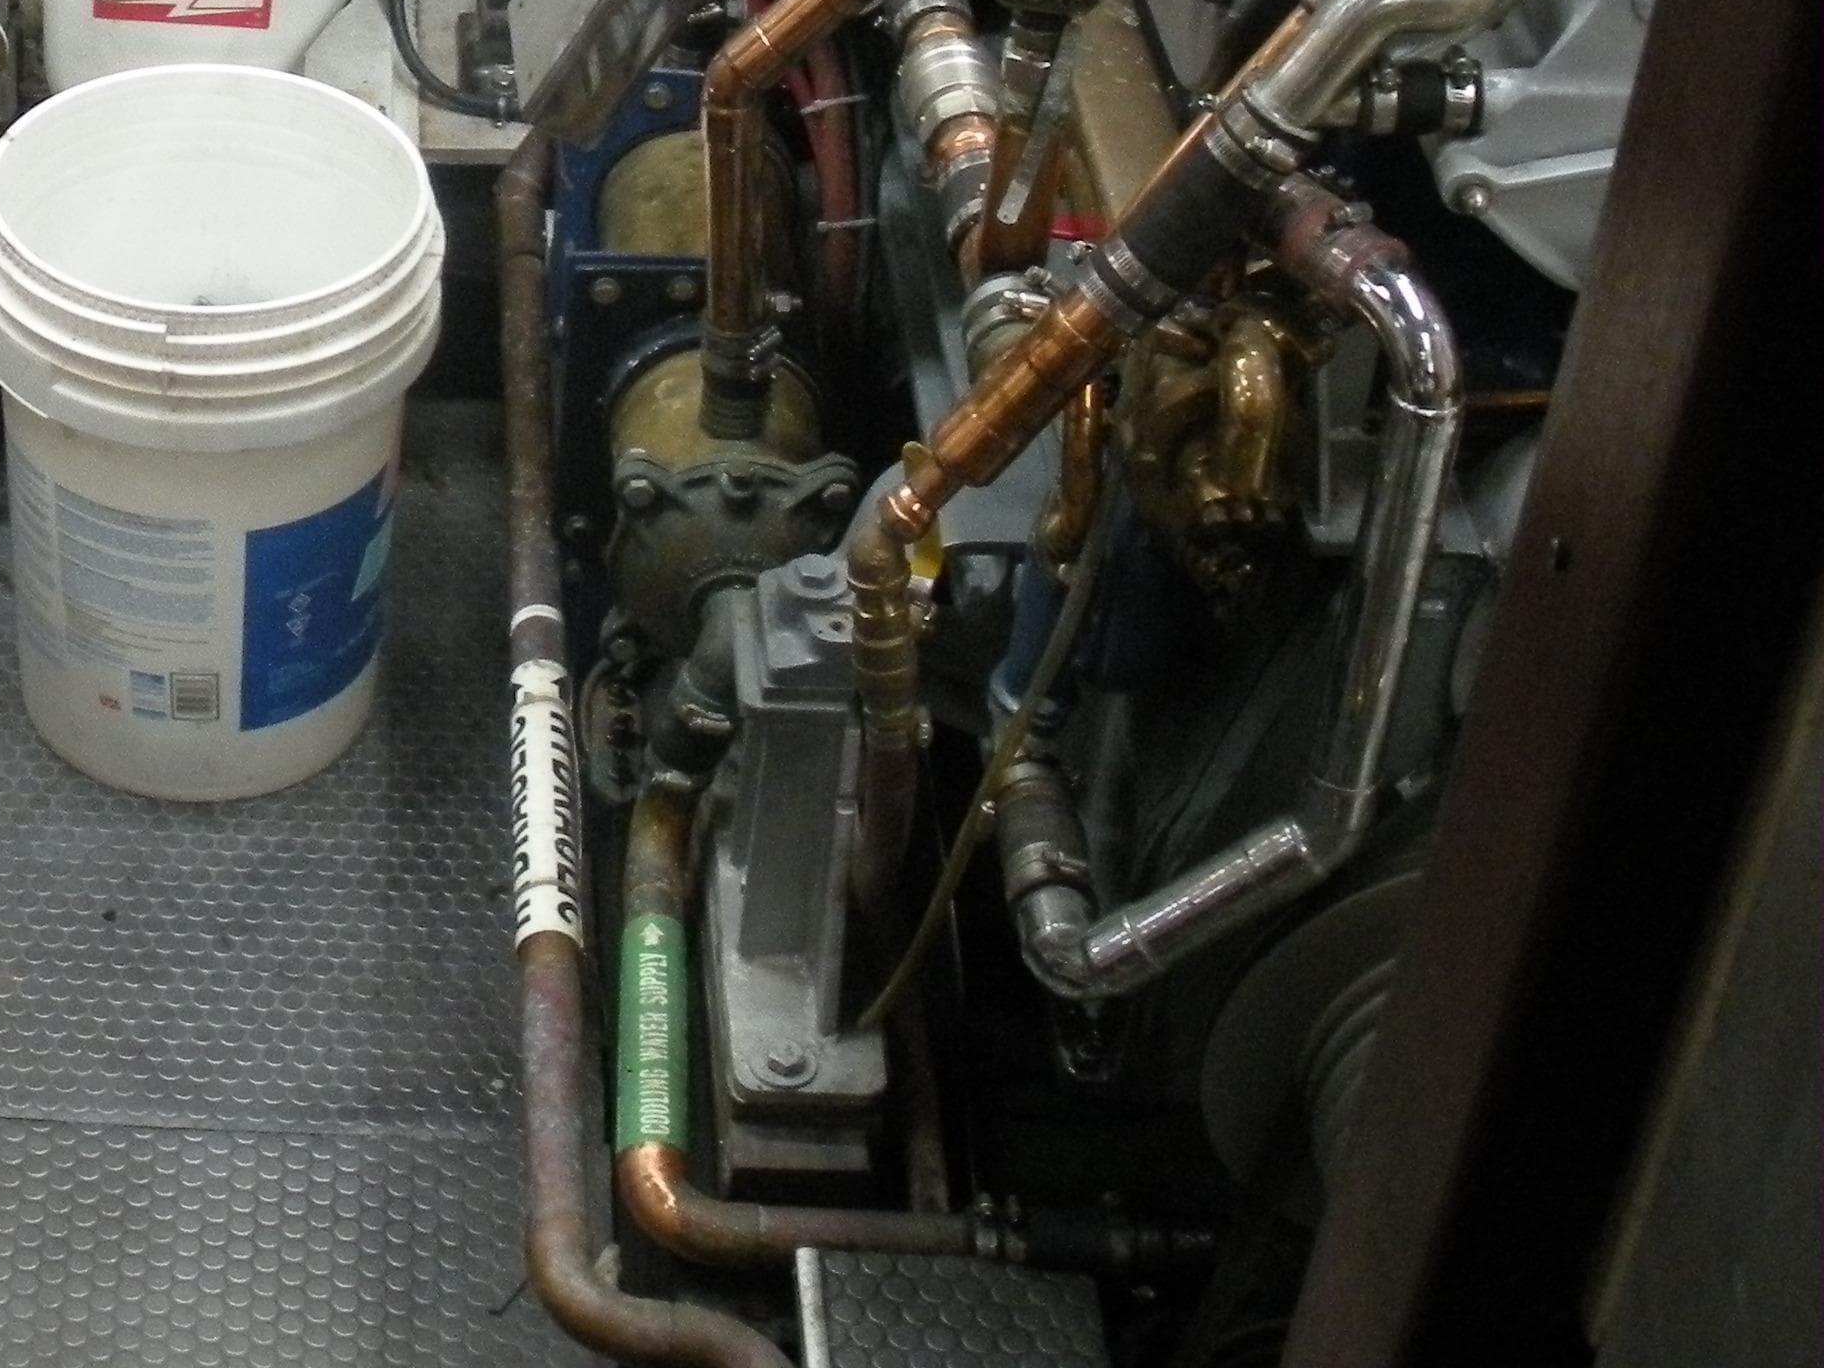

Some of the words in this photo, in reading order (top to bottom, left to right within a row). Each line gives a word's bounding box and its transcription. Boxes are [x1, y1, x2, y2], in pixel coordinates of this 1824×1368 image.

[639, 953, 668, 1006] SUPPLY
[639, 1012, 670, 1062] WATER
[639, 1069, 671, 1135] COOLING
